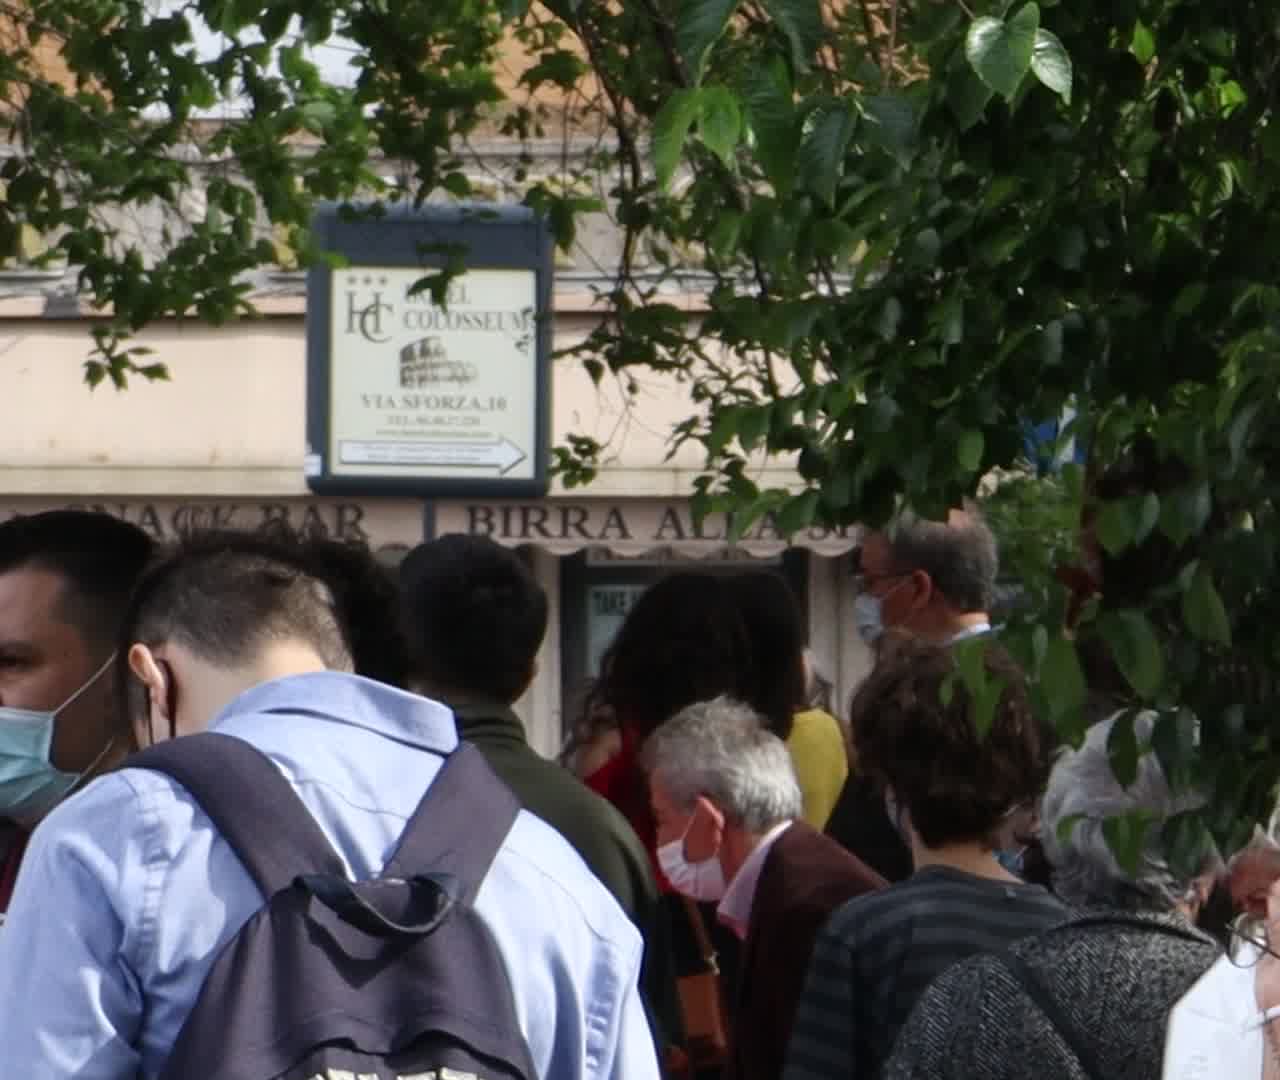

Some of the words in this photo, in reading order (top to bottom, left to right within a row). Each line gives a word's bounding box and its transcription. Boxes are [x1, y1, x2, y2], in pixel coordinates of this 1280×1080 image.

[360, 392, 396, 409] VIA
[259, 503, 370, 543] BAR
[467, 504, 632, 541] BIRRA
